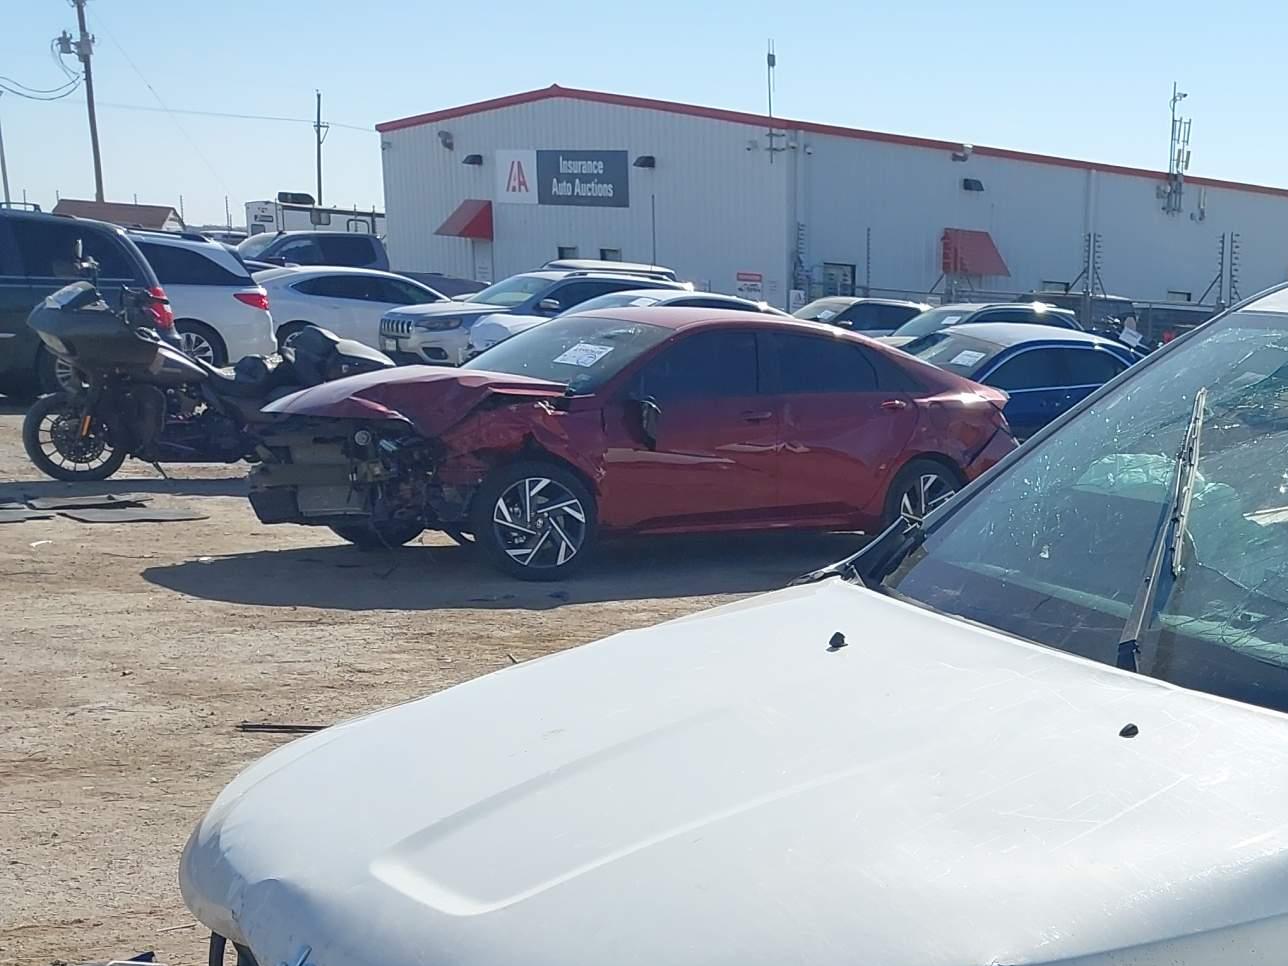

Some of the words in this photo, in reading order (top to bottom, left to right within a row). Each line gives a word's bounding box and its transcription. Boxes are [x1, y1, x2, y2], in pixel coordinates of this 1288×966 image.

[559, 155, 604, 175] Insurance
[551, 178, 573, 197] Auto
[574, 178, 614, 198] Auctions
